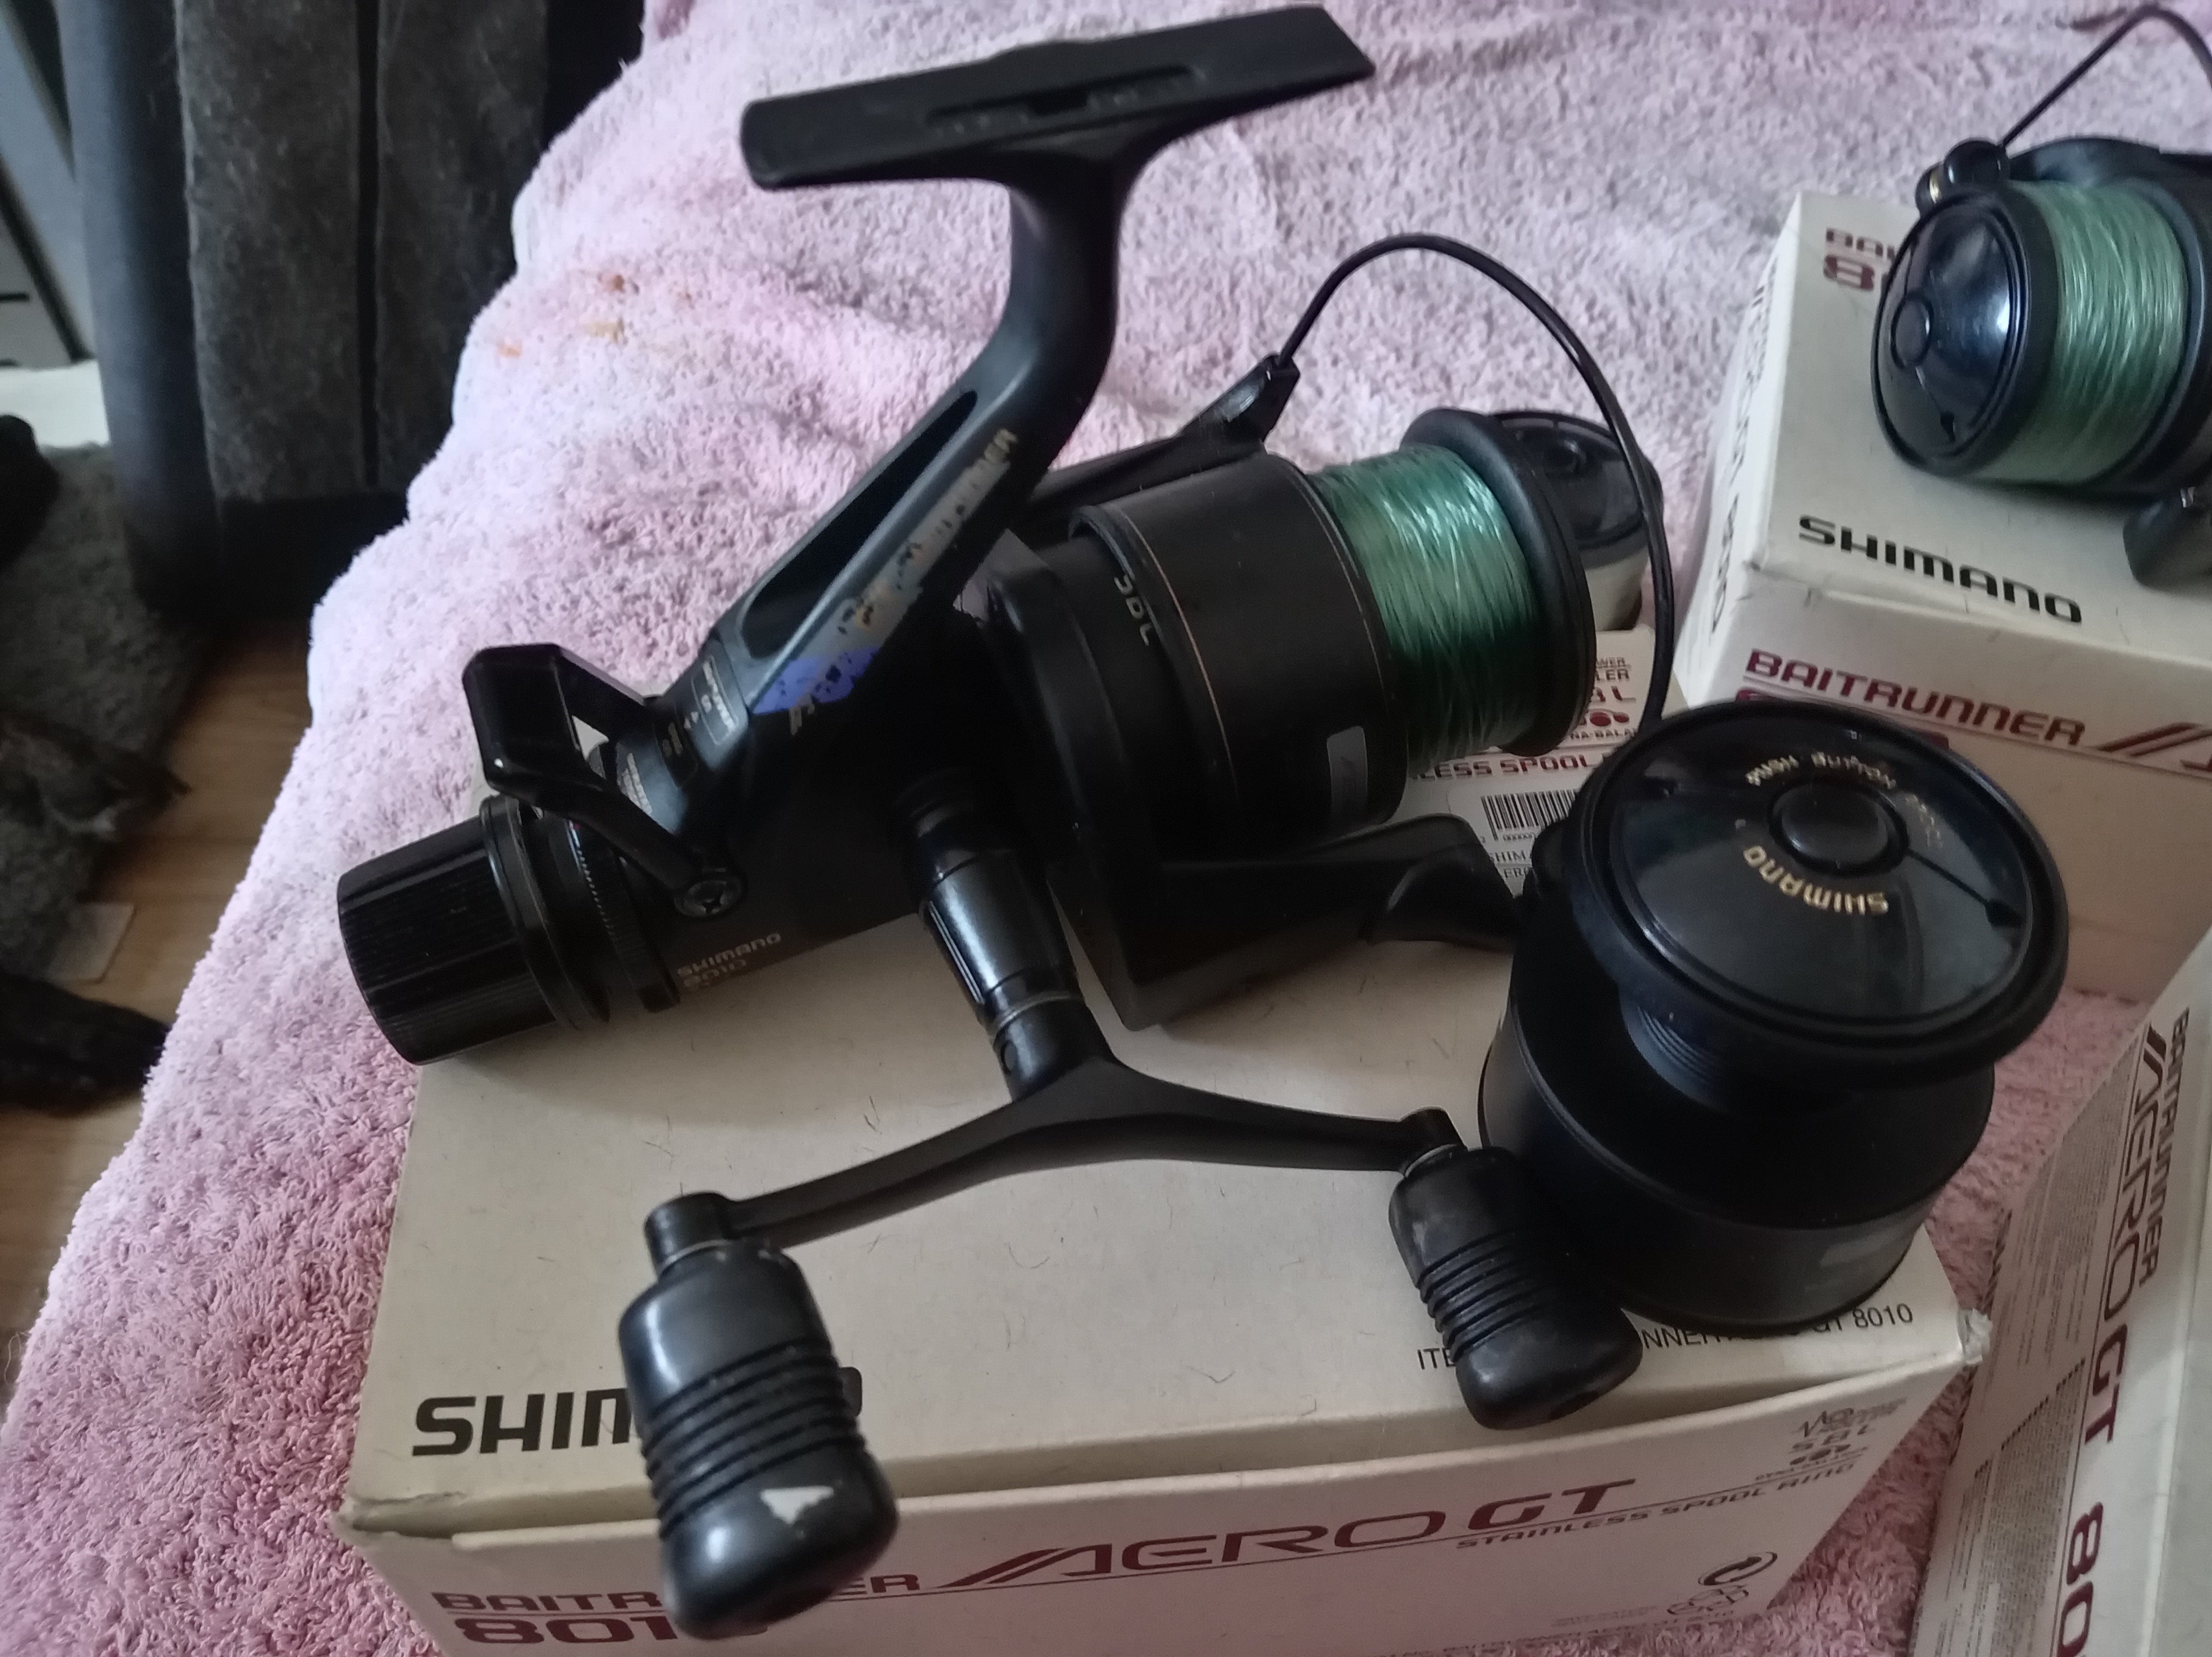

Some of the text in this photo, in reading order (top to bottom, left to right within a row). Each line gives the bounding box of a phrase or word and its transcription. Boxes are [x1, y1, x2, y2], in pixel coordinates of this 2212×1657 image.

[1799, 514, 2082, 624] SHIMANO
[1745, 648, 2086, 746] BAITRUNNER
[1500, 754, 1595, 774] SPOOL
[1742, 845, 1889, 915] SHIMANO
[2139, 1006, 2190, 1287] BAITRUNNER
[1852, 1303, 1914, 1330] 8010
[2085, 1324, 2128, 1444] GT
[411, 1388, 634, 1456] SHIM
[1467, 1478, 1637, 1530] GT
